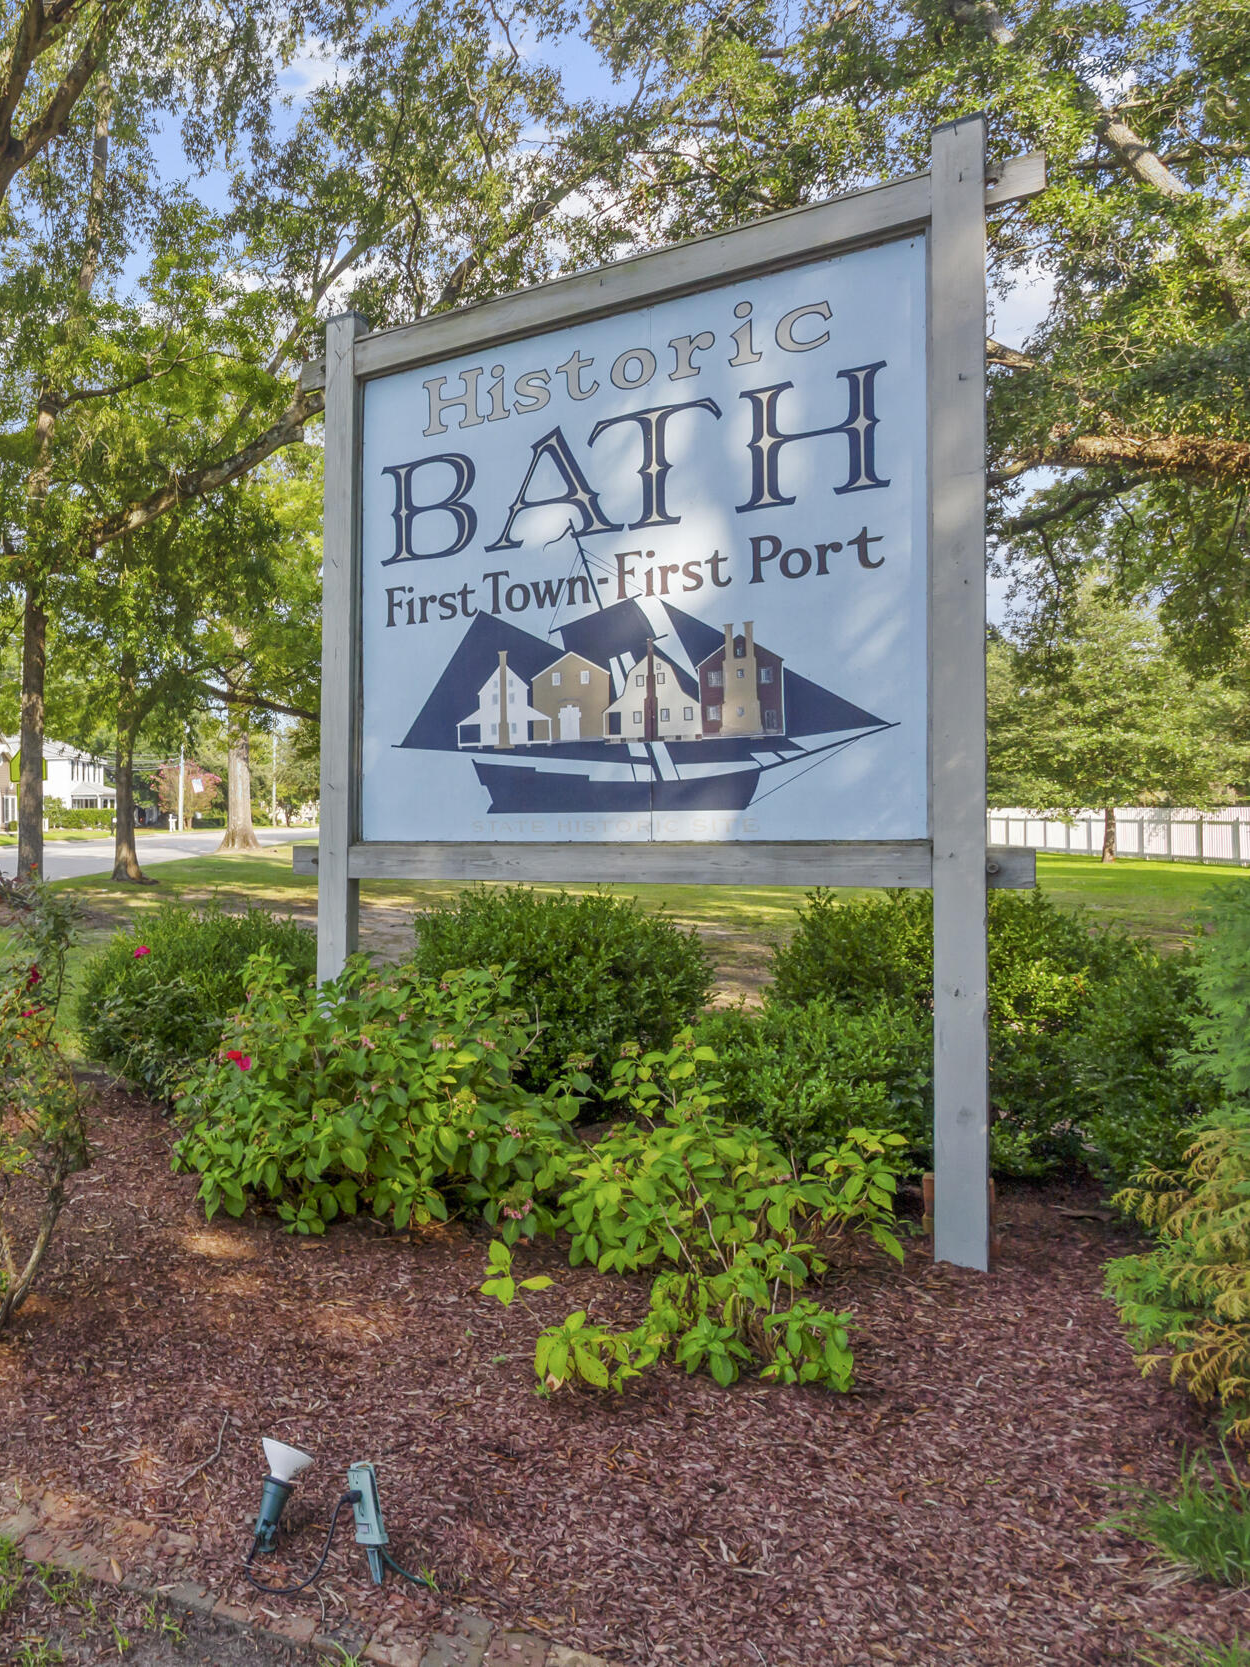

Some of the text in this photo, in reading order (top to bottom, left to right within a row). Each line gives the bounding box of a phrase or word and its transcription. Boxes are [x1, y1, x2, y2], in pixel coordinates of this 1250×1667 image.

[422, 300, 833, 438] Historic
[381, 360, 890, 567] BATH
[385, 585, 478, 628] First
[749, 526, 886, 585] Port
[471, 818, 761, 834] STATE HISTORIC SITE
